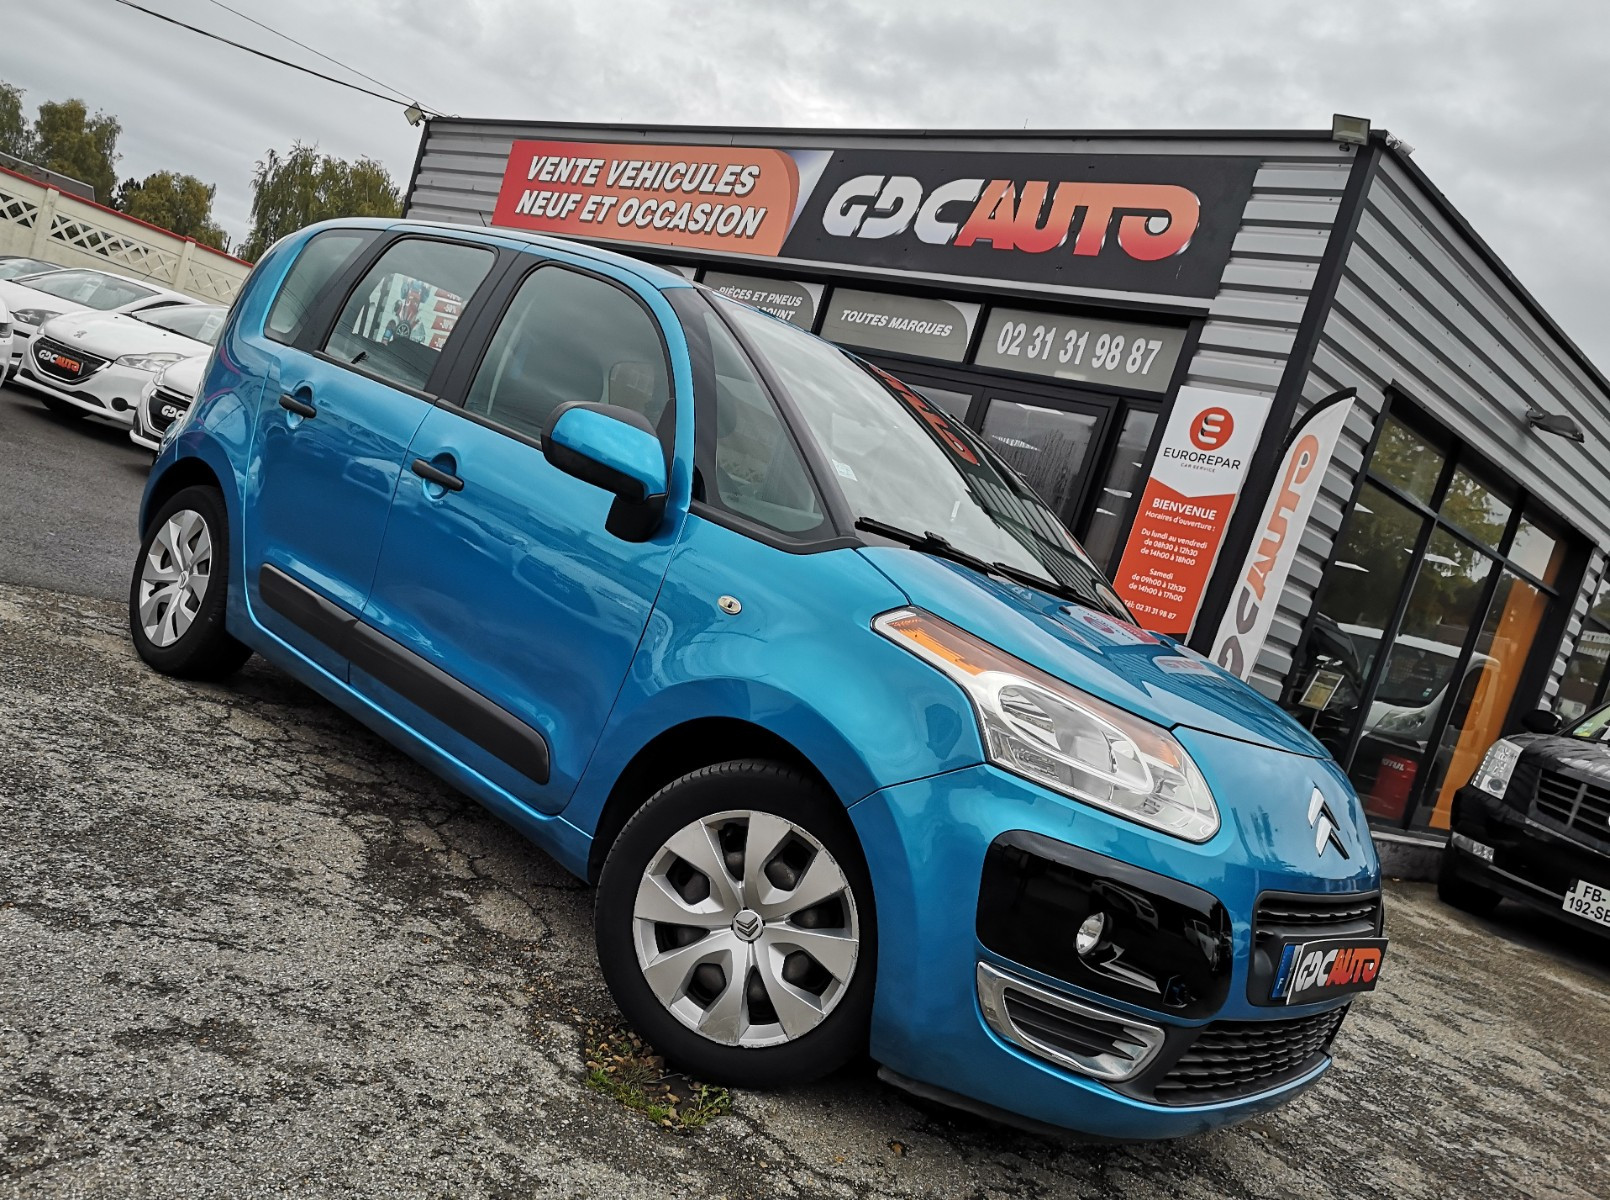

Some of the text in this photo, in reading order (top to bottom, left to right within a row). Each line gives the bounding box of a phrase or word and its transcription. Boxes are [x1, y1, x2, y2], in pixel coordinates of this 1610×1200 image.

[527, 155, 760, 195] VENTE VEHICULES
[514, 190, 767, 237] NEUF ET OCCASION
[822, 175, 1200, 261] GDCAUTO
[752, 291, 768, 302] ET
[765, 293, 803, 307] PNEUS
[840, 309, 953, 337] TOUTES MARQUES
[996, 321, 1163, 375] 02 31 31 98 87
[1163, 447, 1241, 470] EUROREPAR
[1192, 464, 1216, 473] SERVICE
[1145, 510, 1172, 522] Horaires
[1173, 515, 1212, 530] d'ouverture
[1152, 498, 1217, 521] BIENVENUE
[1141, 528, 1150, 536] Du
[1151, 530, 1168, 540] lundi
[1177, 537, 1208, 549] vendredi
[1144, 538, 1152, 546] de
[1153, 540, 1173, 551] 08h30
[1179, 547, 1198, 557] 12h30
[1150, 549, 1170, 559] 14h00
[1175, 555, 1196, 566] 18h00
[1140, 575, 1161, 586] 09h00
[1167, 582, 1186, 593] 12h30
[1149, 568, 1173, 580] Samedi
[1138, 584, 1157, 595] 14h00
[1163, 591, 1183, 602] 17h00
[1124, 599, 1177, 620] Tél: 02 31 31 98 87
[1294, 948, 1381, 992] GDCAUTO
